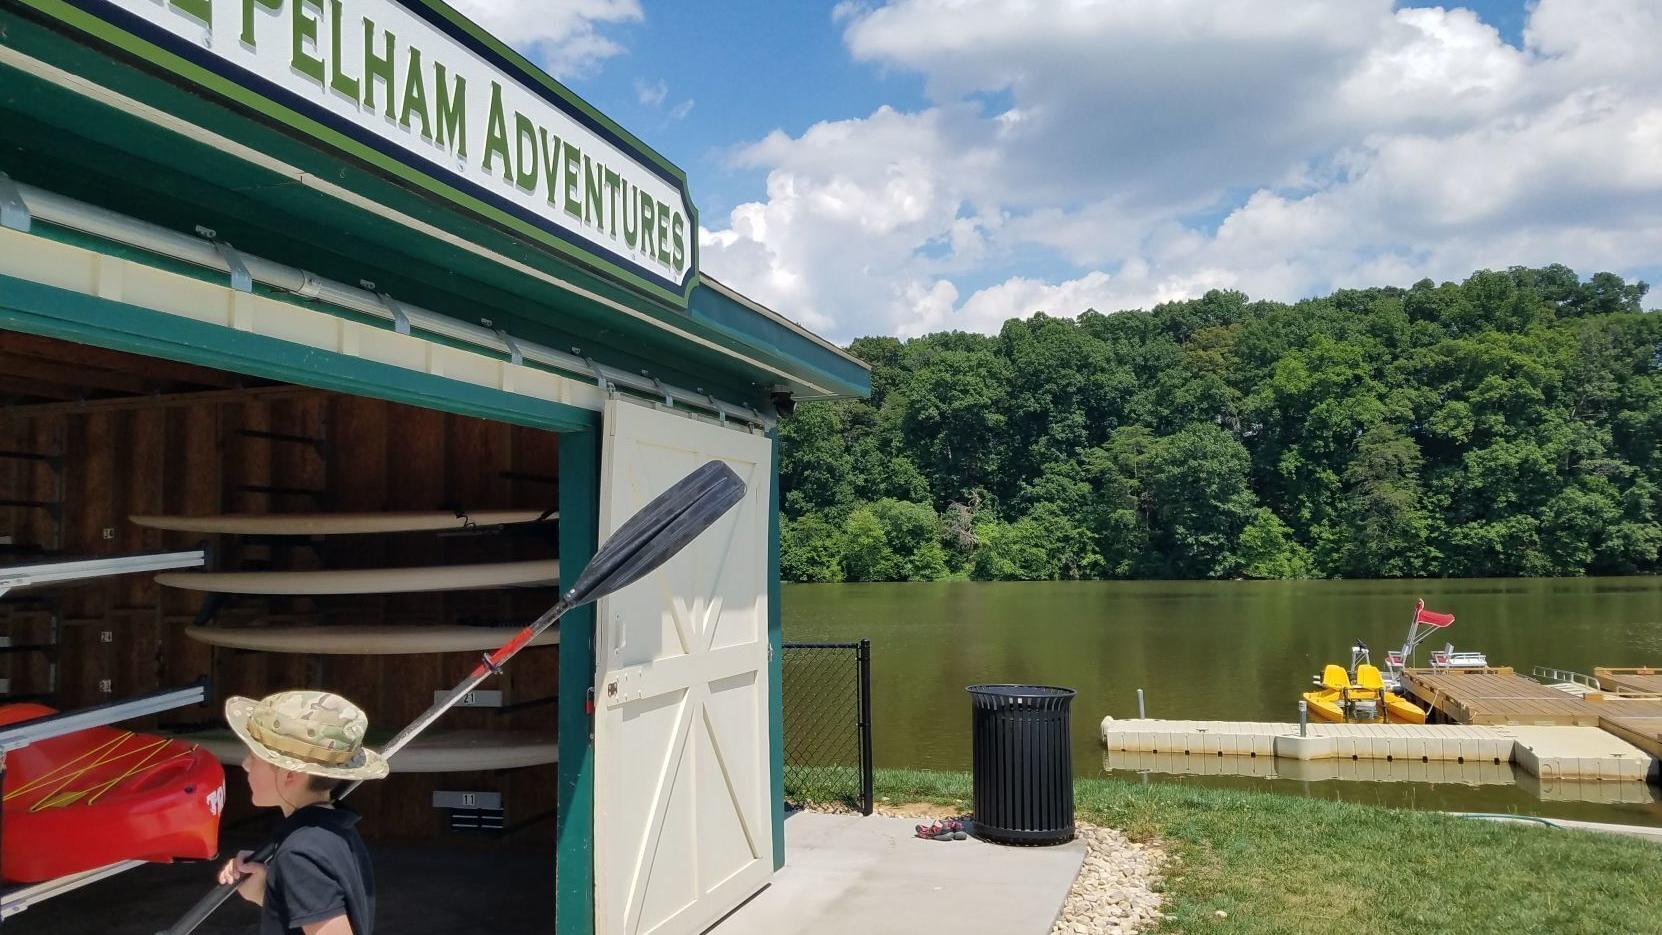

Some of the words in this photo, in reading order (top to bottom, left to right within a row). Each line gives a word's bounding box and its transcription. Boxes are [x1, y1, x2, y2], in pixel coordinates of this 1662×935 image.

[481, 79, 685, 273] ADVENTURES
[463, 693, 475, 704] 21
[463, 793, 475, 806] 11
